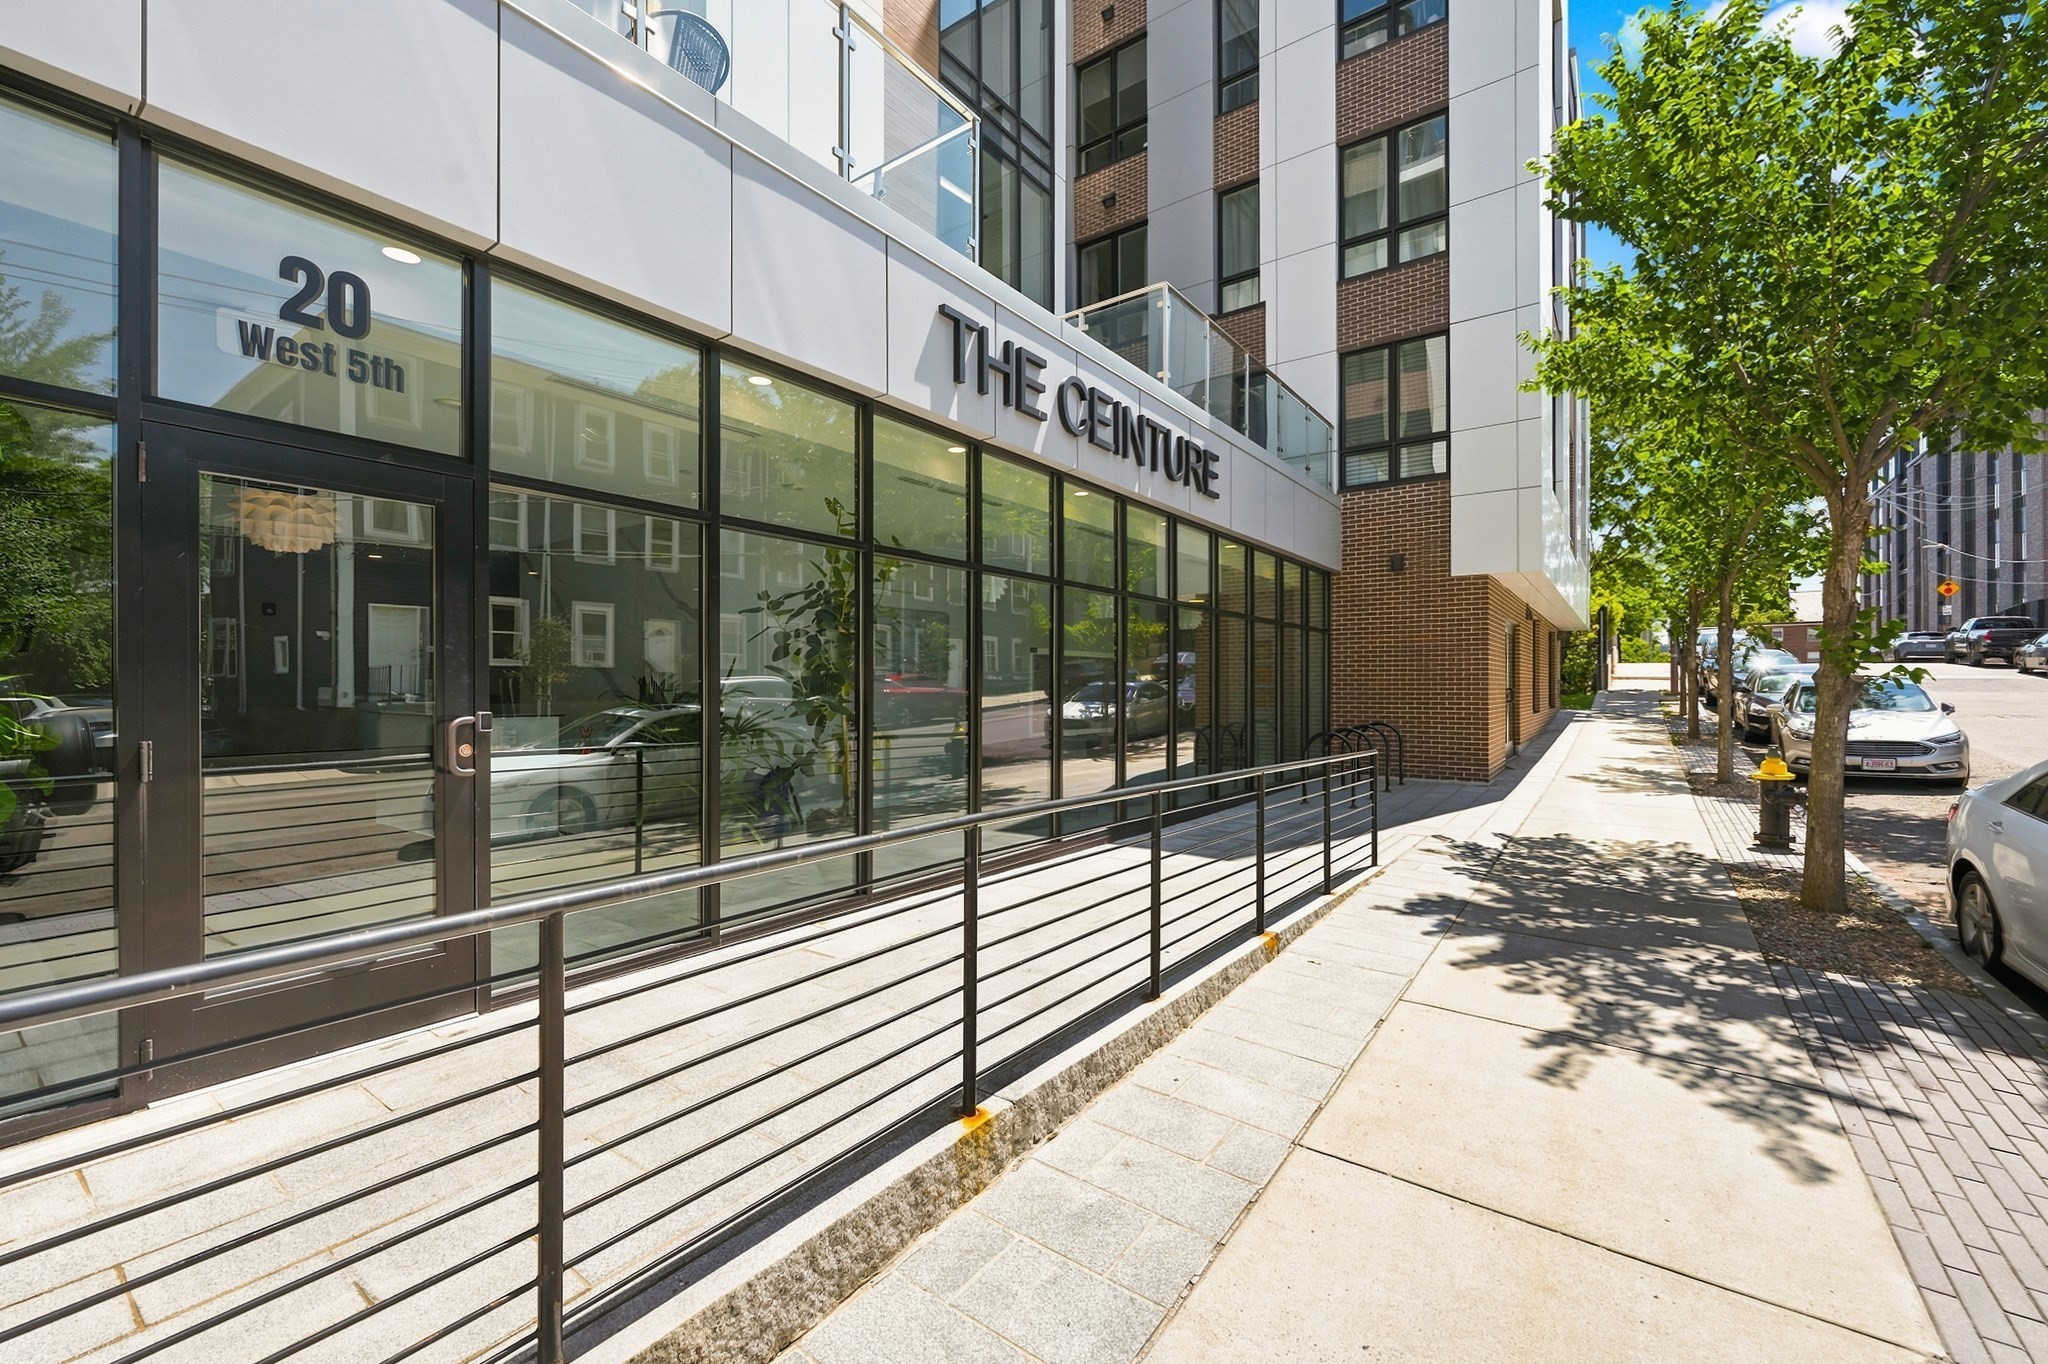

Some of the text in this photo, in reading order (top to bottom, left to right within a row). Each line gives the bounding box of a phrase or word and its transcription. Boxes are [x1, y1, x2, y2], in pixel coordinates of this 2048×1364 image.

[279, 255, 372, 340] 20
[238, 319, 405, 394] West 5th
[938, 303, 1220, 500] THE CEINTURE
